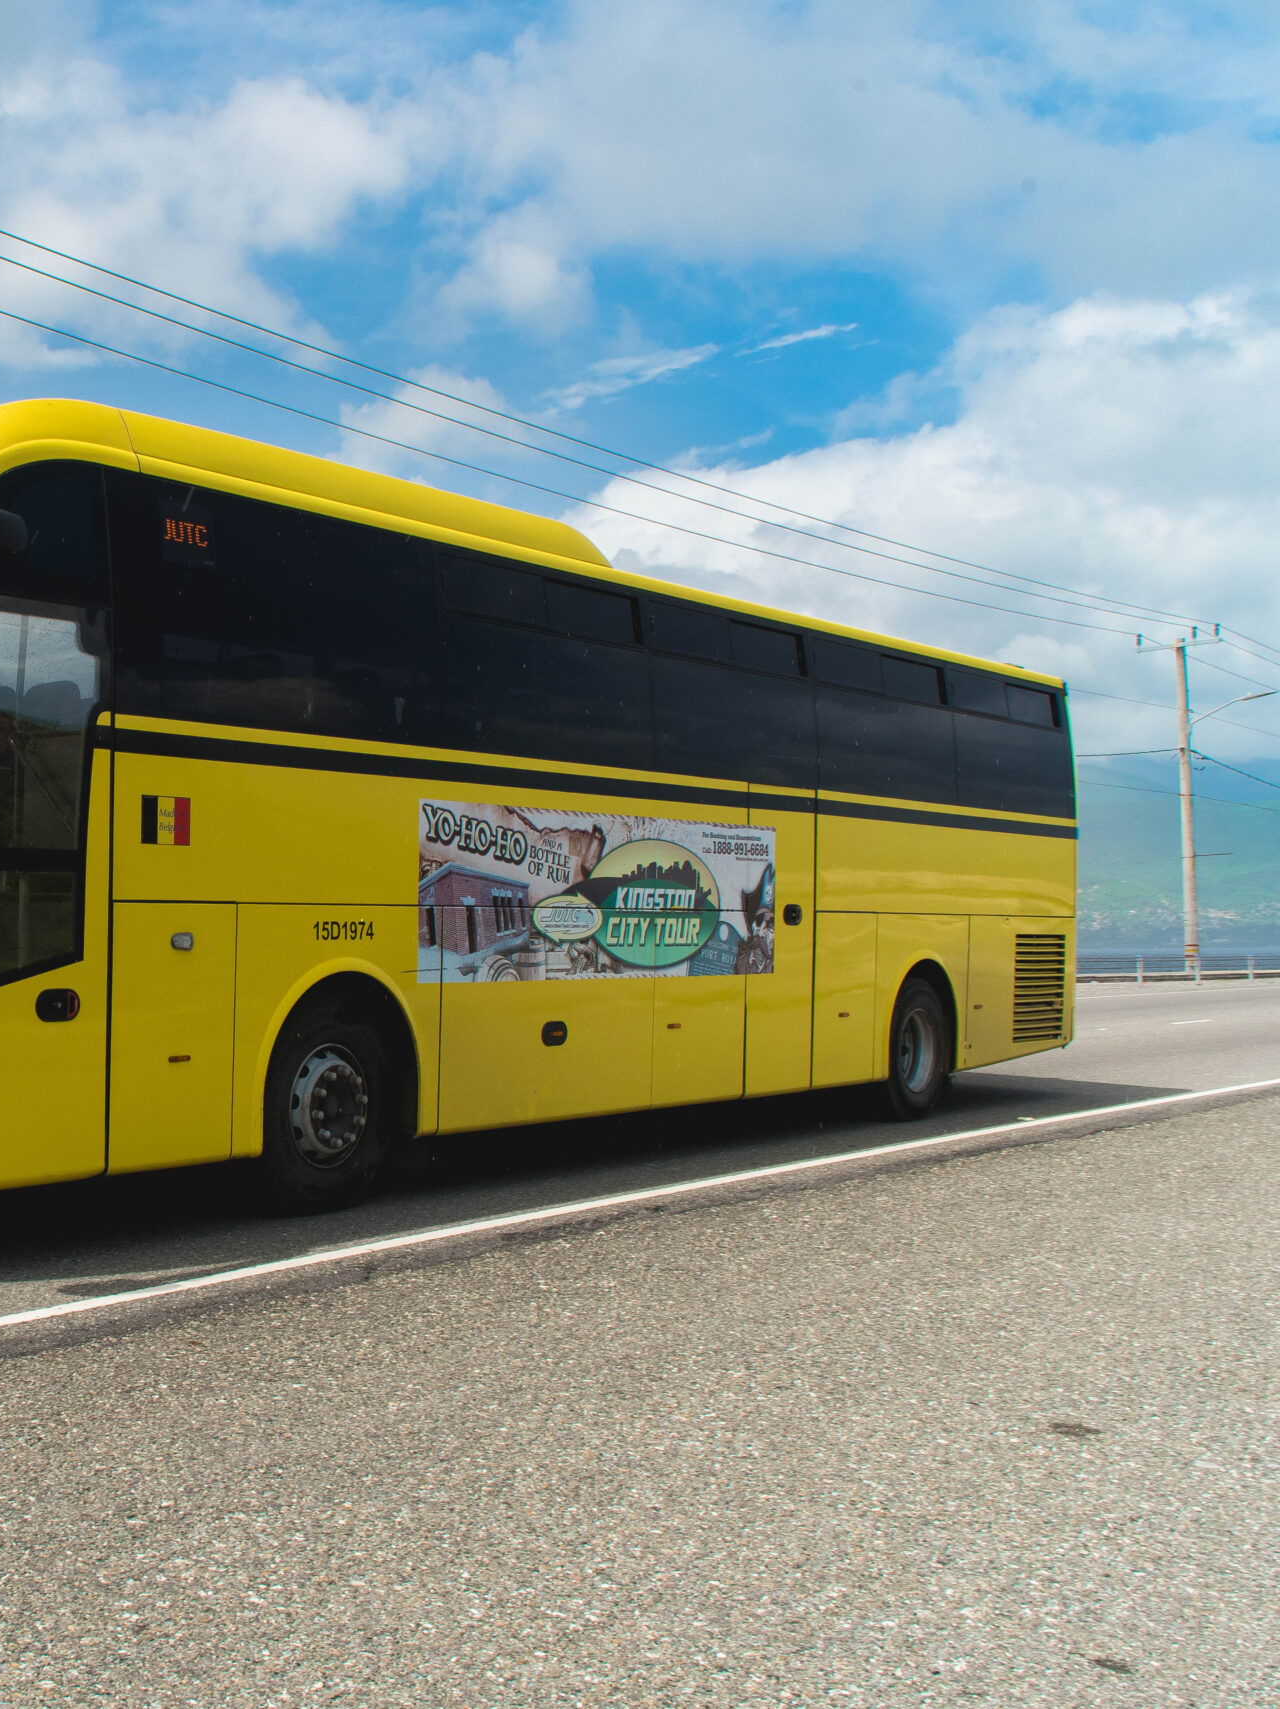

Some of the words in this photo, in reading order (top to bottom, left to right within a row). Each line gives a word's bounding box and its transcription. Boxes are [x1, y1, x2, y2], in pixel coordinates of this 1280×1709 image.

[164, 519, 208, 547] JUTC
[159, 822, 185, 834] Belg
[422, 803, 527, 864] YO-HO-HO
[542, 839, 556, 850] AND
[713, 841, 769, 857] 1888-991-6684
[529, 845, 571, 870] BOTTLE
[528, 860, 544, 877] OF
[547, 865, 571, 885] RUM
[616, 887, 696, 912] KINGSTON
[313, 921, 374, 940] 15D1974
[606, 917, 651, 946] CITY
[654, 917, 701, 946] TOUR
